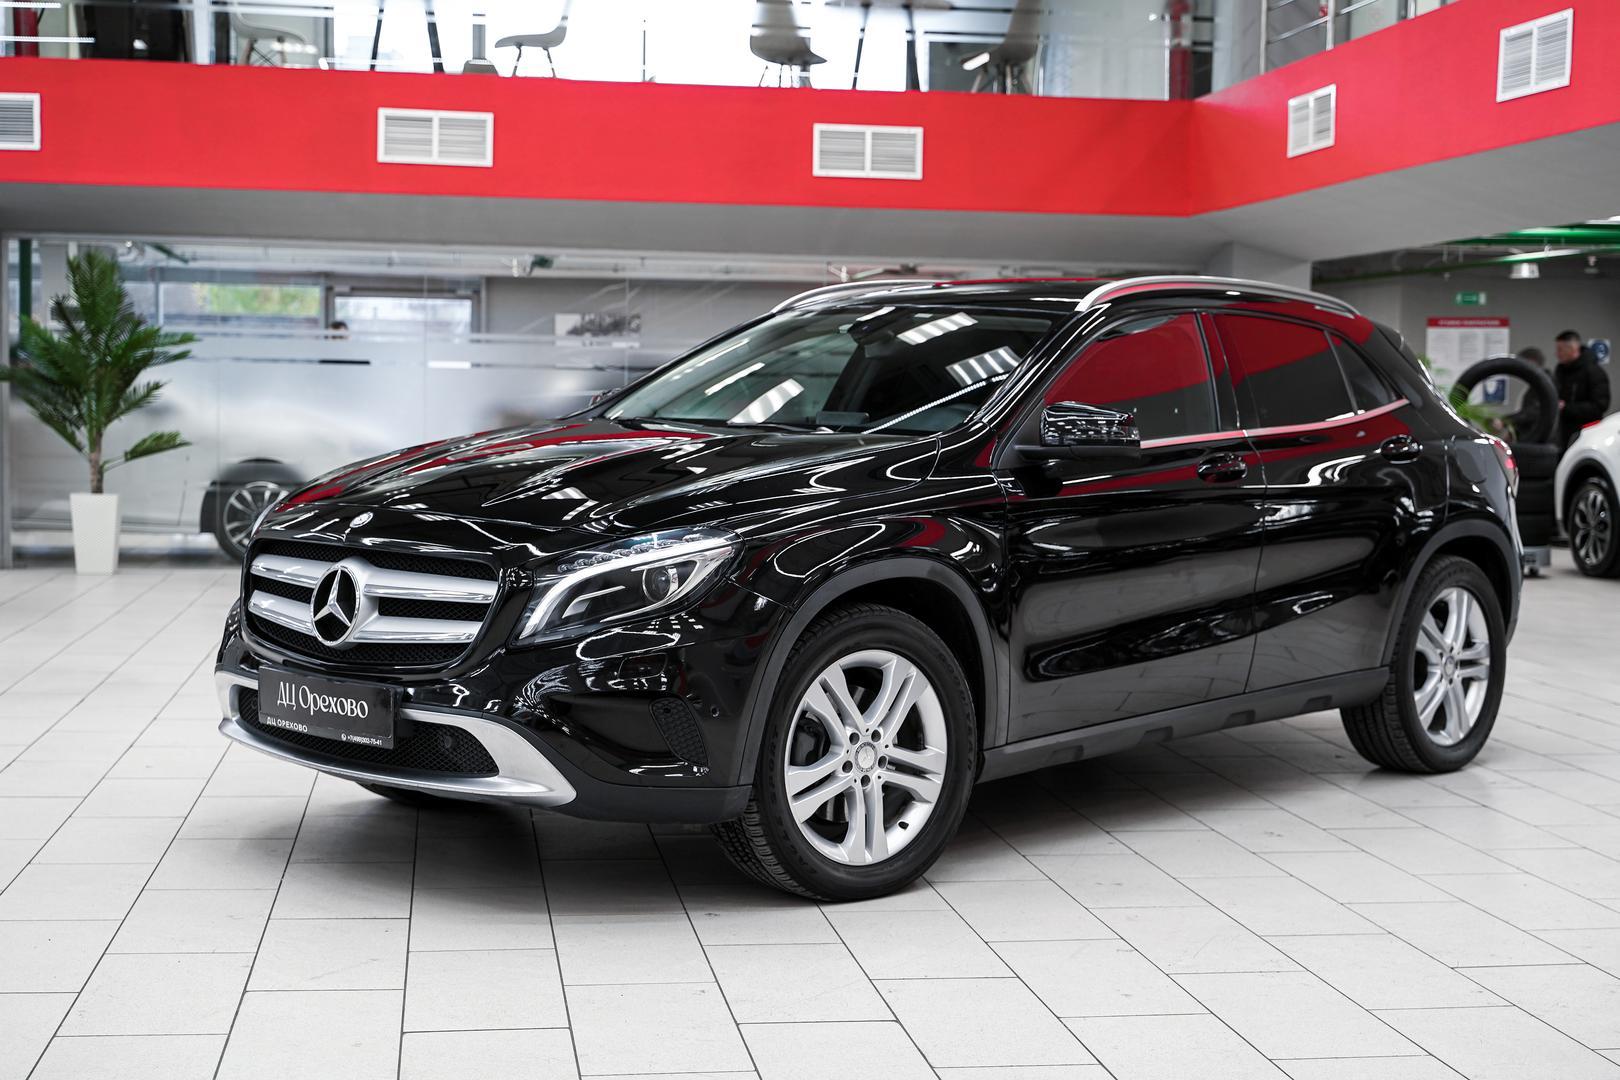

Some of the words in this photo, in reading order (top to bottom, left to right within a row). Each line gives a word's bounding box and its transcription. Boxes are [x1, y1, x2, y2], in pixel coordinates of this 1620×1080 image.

[277, 681, 297, 710] ДЦ
[299, 685, 369, 719] Орехово
[266, 716, 276, 726] ДЦ
[277, 719, 308, 732] ОРЕХОВО
